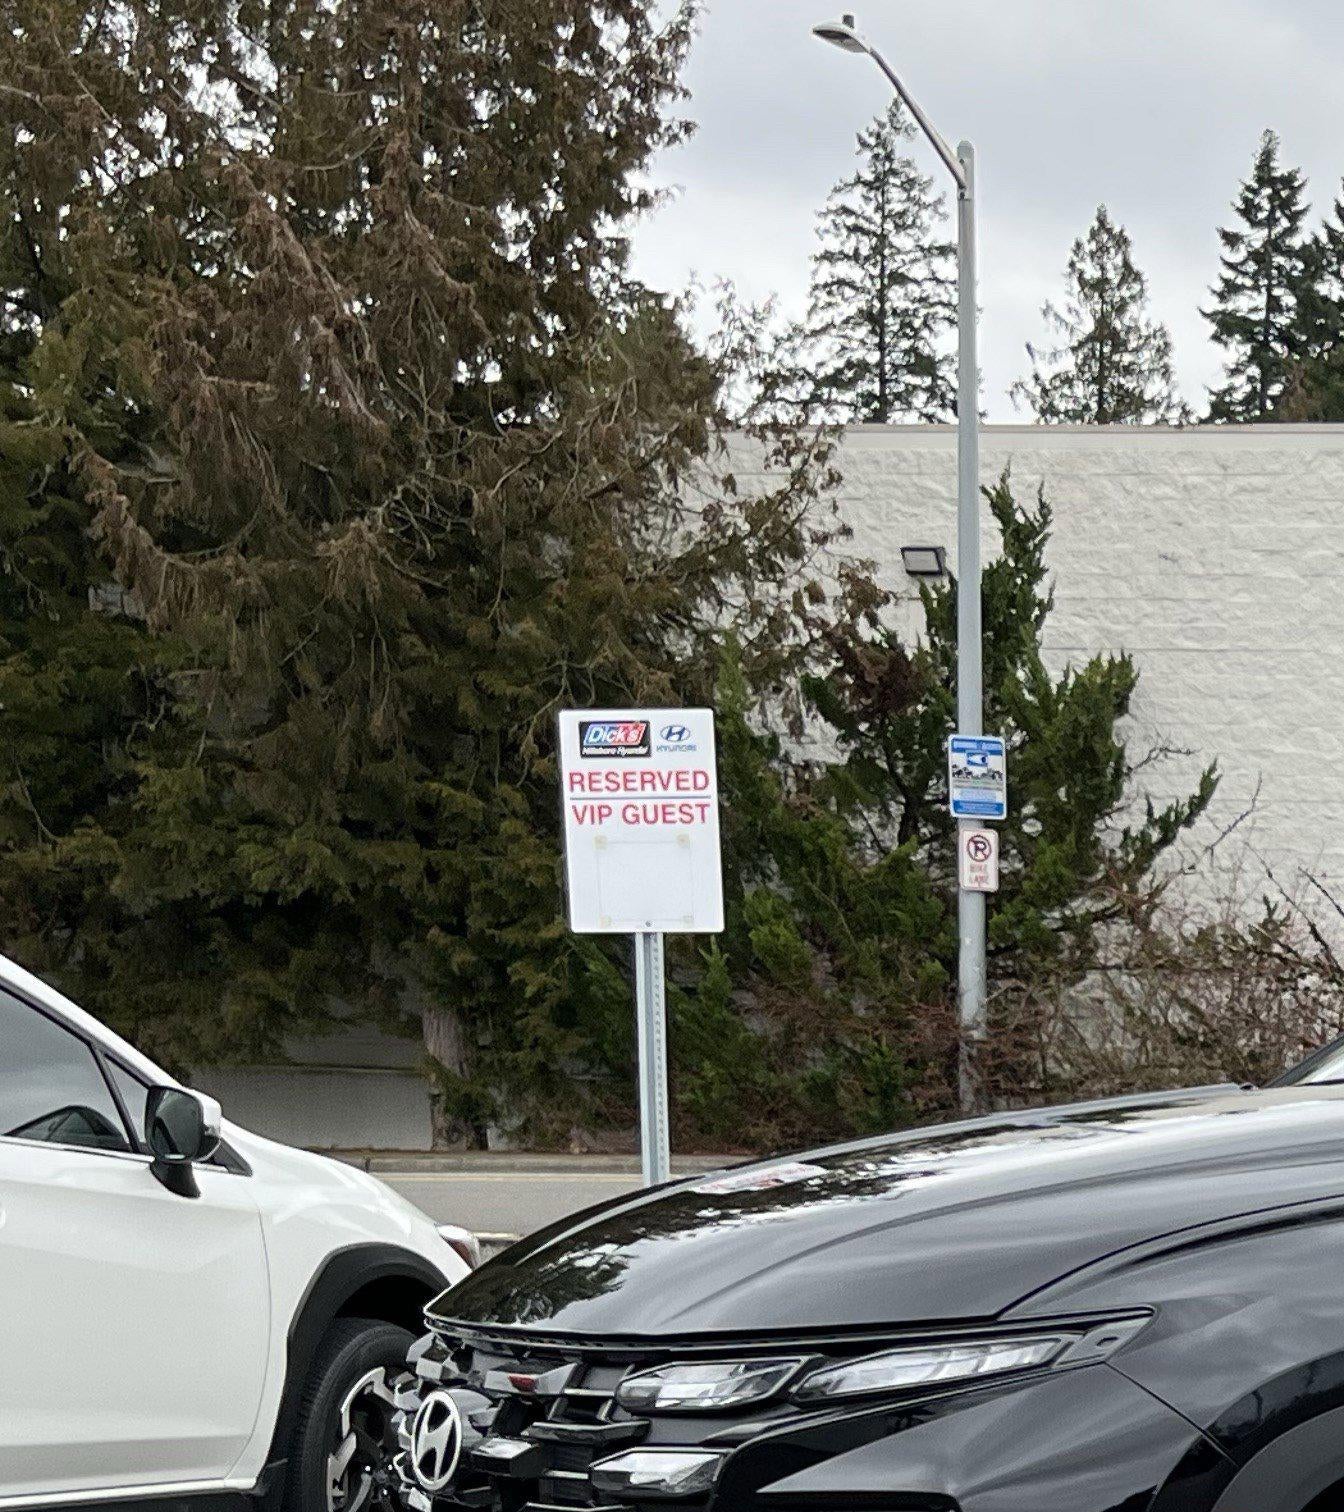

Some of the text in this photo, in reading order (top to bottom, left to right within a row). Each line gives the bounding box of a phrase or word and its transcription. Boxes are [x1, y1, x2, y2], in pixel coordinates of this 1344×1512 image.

[569, 770, 710, 792] RESERVED
[572, 803, 711, 825] VIP GUEST
